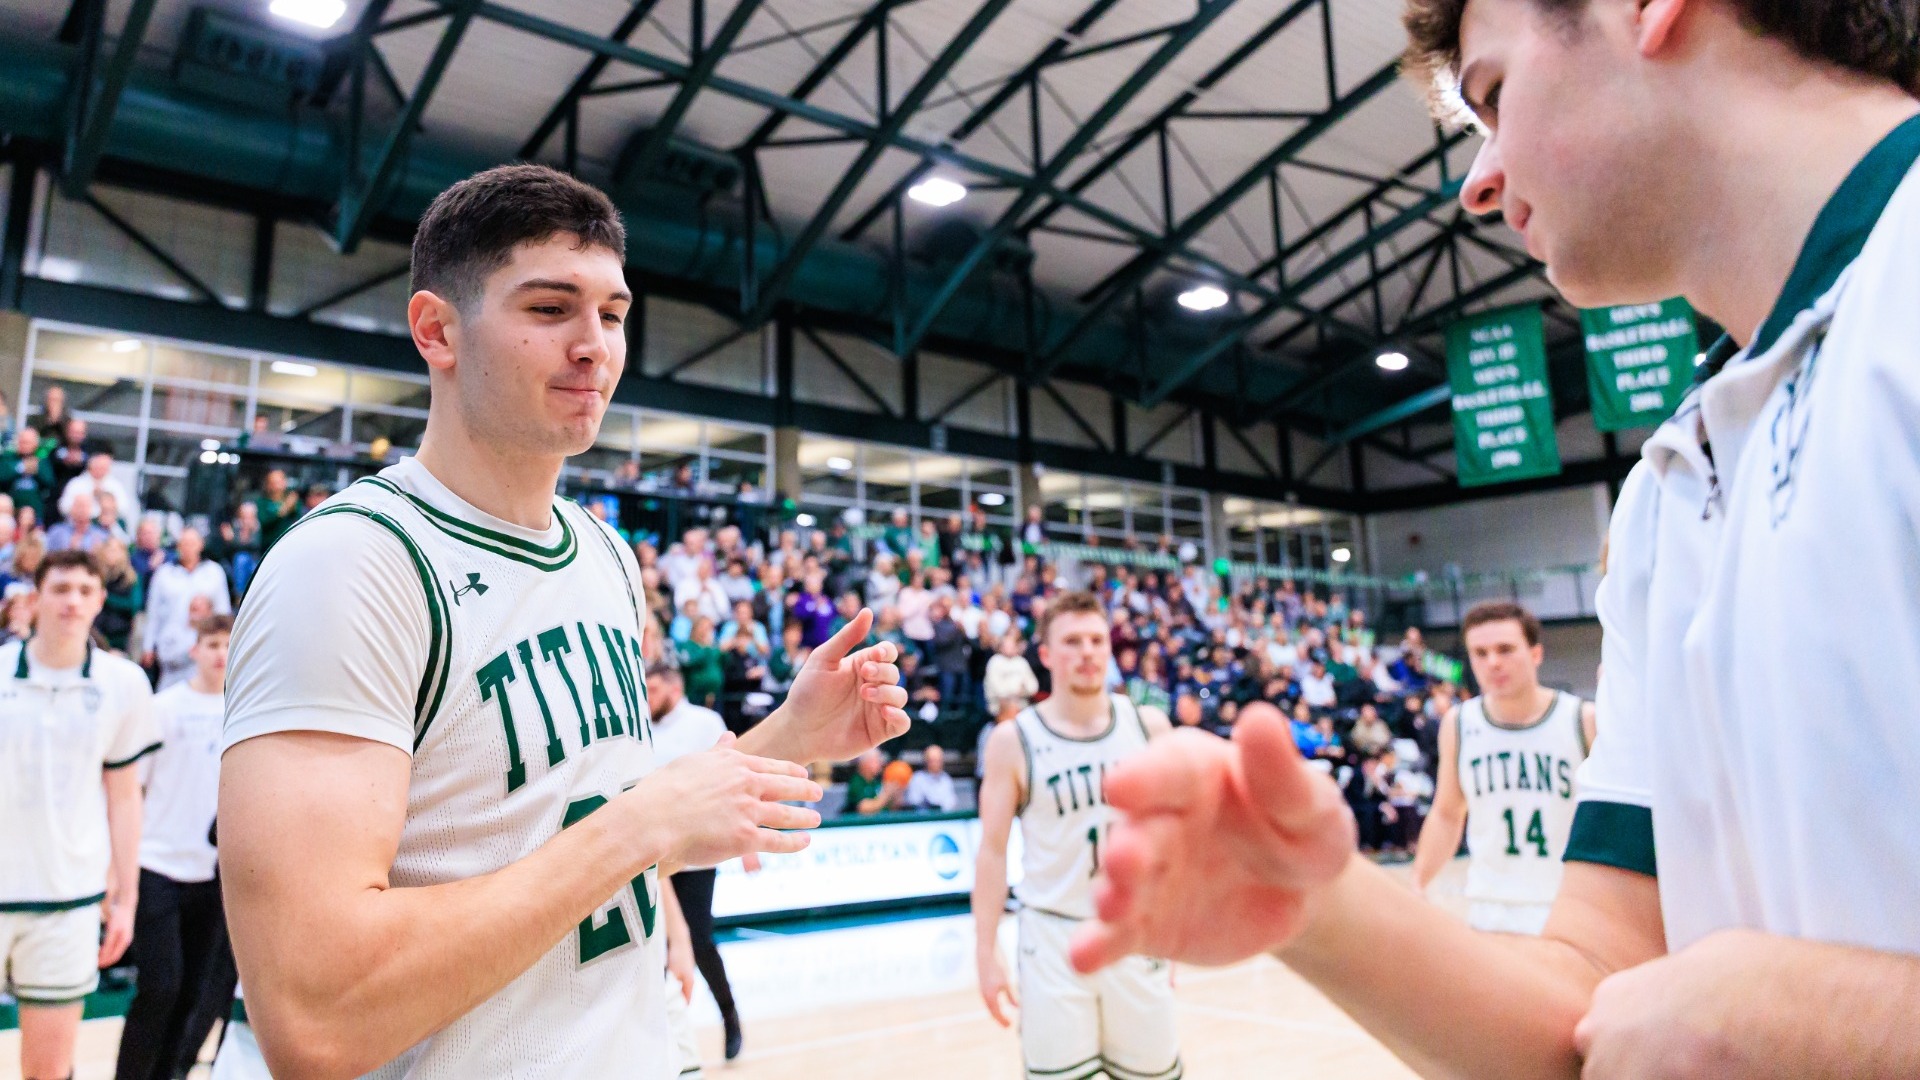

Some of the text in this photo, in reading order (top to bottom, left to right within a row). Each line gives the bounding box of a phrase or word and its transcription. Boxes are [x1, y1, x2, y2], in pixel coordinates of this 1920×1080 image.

[1585, 317, 1692, 353] BASKETBALL
[1612, 344, 1669, 370] THIRD
[1473, 364, 1520, 386] MEN'S
[1615, 365, 1671, 392] PLACE
[1452, 380, 1547, 412] BASKETBALL
[1475, 405, 1525, 428] THIRD
[1477, 426, 1528, 450] PLACE
[1470, 751, 1572, 799] TITANS
[1502, 808, 1549, 857] 14
